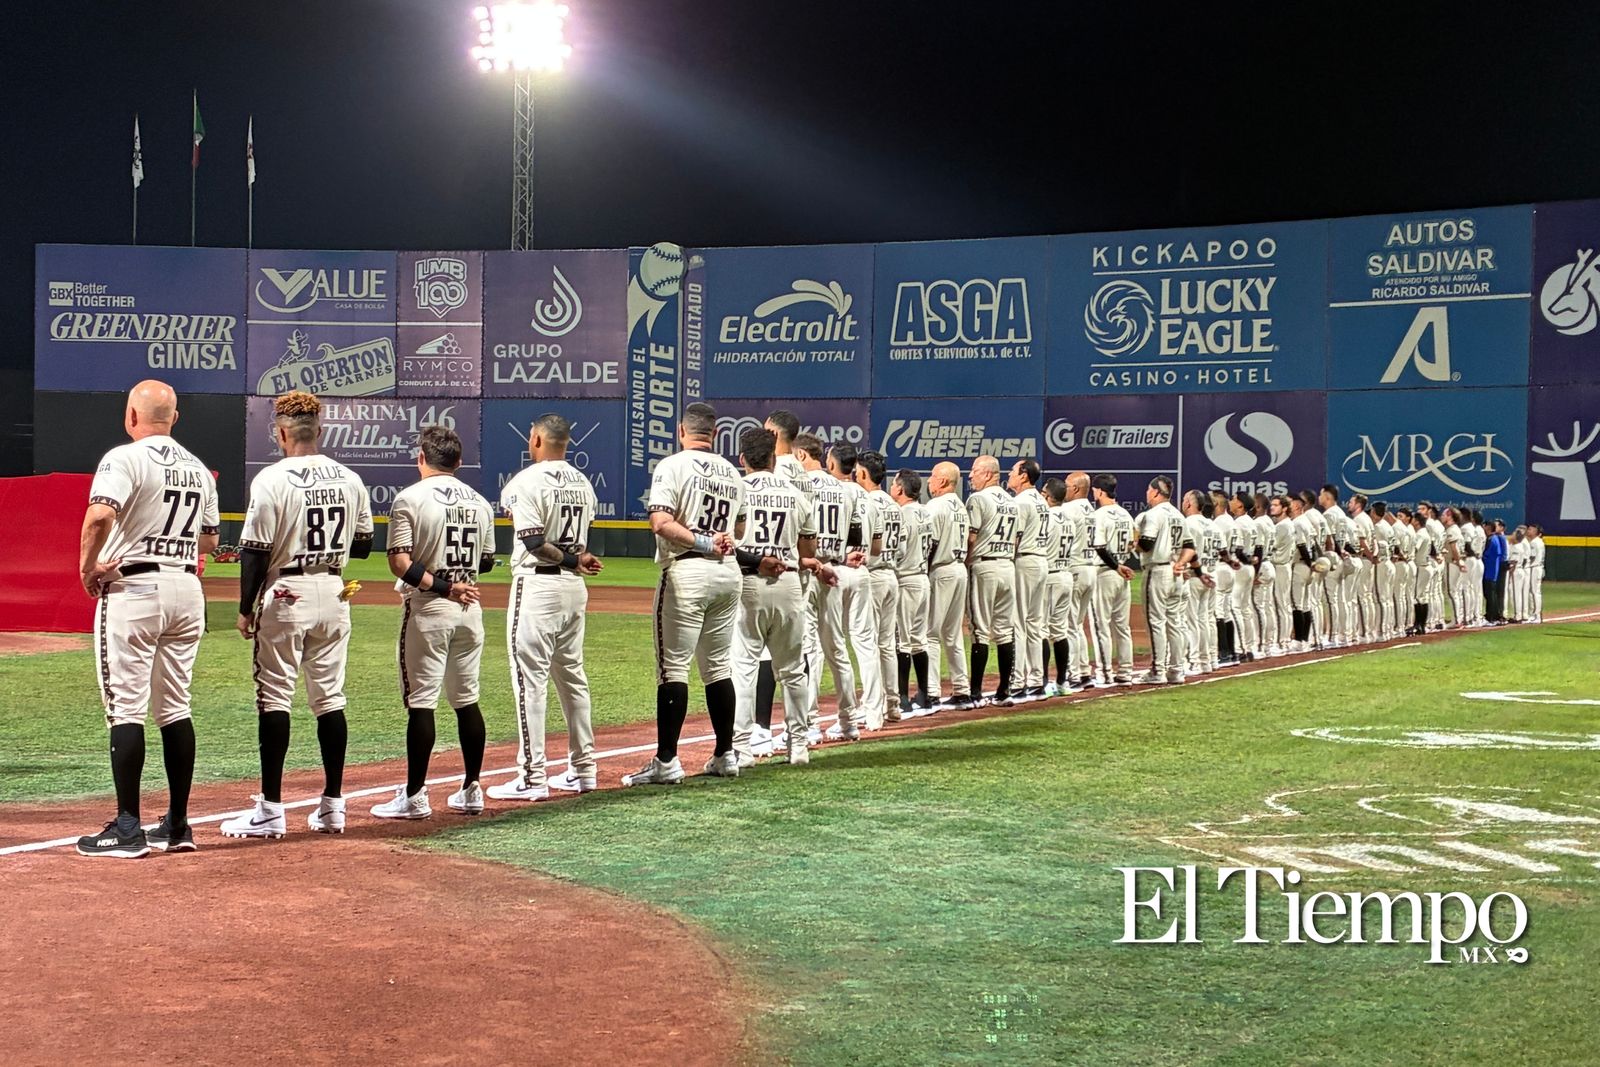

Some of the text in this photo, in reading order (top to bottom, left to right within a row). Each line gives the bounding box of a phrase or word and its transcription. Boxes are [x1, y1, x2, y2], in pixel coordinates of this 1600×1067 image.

[1386, 218, 1475, 246] AUTOS
[1092, 237, 1277, 268] KICKAPOO
[1367, 247, 1495, 275] SALDIVAR
[416, 258, 466, 281] LMB
[50, 287, 73, 301] GBX
[75, 282, 108, 294] Better
[260, 267, 387, 305] VALUE
[416, 281, 468, 308] 100
[1160, 276, 1277, 316] LUCKY
[1371, 282, 1490, 299] RICARDO SALDIVAR
[75, 295, 136, 308] TOGETHER
[890, 277, 1032, 347] ASGA
[50, 311, 237, 342] GREENBRIER
[719, 313, 858, 343] Electrolit
[1159, 318, 1275, 356] EAGLE
[493, 343, 563, 358] GRUPO
[687, 282, 702, 398] ES RESULTADO
[148, 343, 237, 370] GIMSA
[713, 349, 855, 363] ¡HIDRATACIÓN TOTAL!
[890, 346, 1032, 360] CORTES Y SERVICIOS S.A. de C.V.
[271, 346, 390, 394] EL OFERTON
[403, 360, 473, 372] RYMCO
[493, 361, 619, 384] LAZALDE
[1090, 368, 1272, 387] CASINO HOTEL
[310, 365, 393, 394] DE CARNES
[325, 404, 457, 432] HARINA 146
[631, 347, 646, 467] IMPULSANDO EL
[322, 424, 409, 448] Miller
[922, 420, 985, 438] GRUAS
[1085, 429, 1107, 445] GG
[1112, 428, 1169, 445] Trailers
[381, 451, 397, 459] 1879
[915, 438, 1036, 458] RESEMSA
[1356, 431, 1498, 474] MRCI
[165, 468, 203, 488] ROJAS
[287, 465, 345, 484] VALUE
[1207, 477, 1288, 497] simas
[305, 488, 346, 507] SIERRA
[554, 489, 587, 505] RUSSELL
[693, 475, 737, 500] FUENMAYOR
[162, 490, 202, 538] 72
[445, 506, 478, 525] NUÑEZ
[558, 505, 584, 544] 27
[697, 494, 731, 533] 38
[817, 504, 839, 535] 10
[307, 506, 346, 551] 82
[754, 509, 787, 545] 37
[885, 522, 900, 549] 23
[994, 516, 1016, 541] 47
[141, 536, 197, 561] TECATE
[446, 526, 478, 568] 55
[1058, 536, 1074, 558] 52
[1117, 530, 1127, 552] 15
